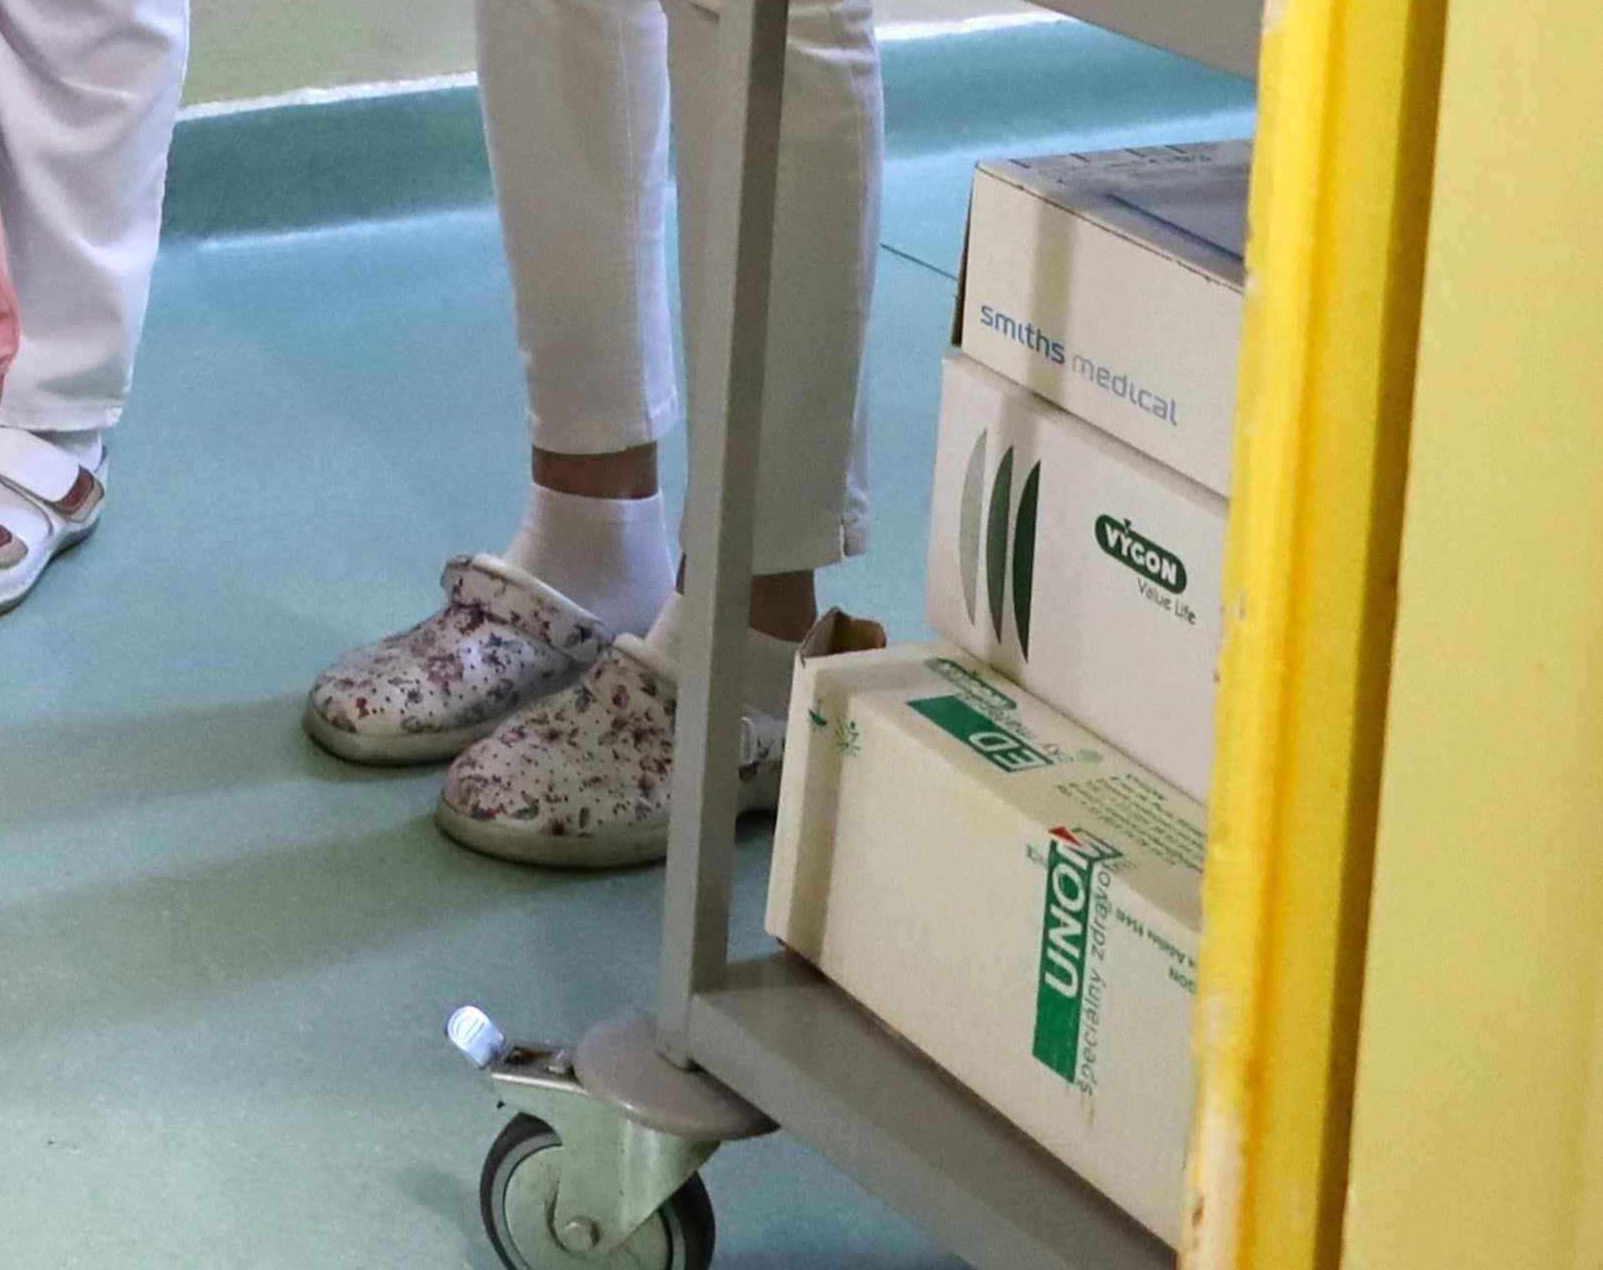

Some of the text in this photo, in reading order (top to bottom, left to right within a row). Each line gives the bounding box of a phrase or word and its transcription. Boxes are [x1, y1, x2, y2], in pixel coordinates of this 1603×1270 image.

[980, 304, 1179, 427] smiths medical
[1104, 522, 1178, 586] VYGON
[1137, 577, 1197, 626] Value Life
